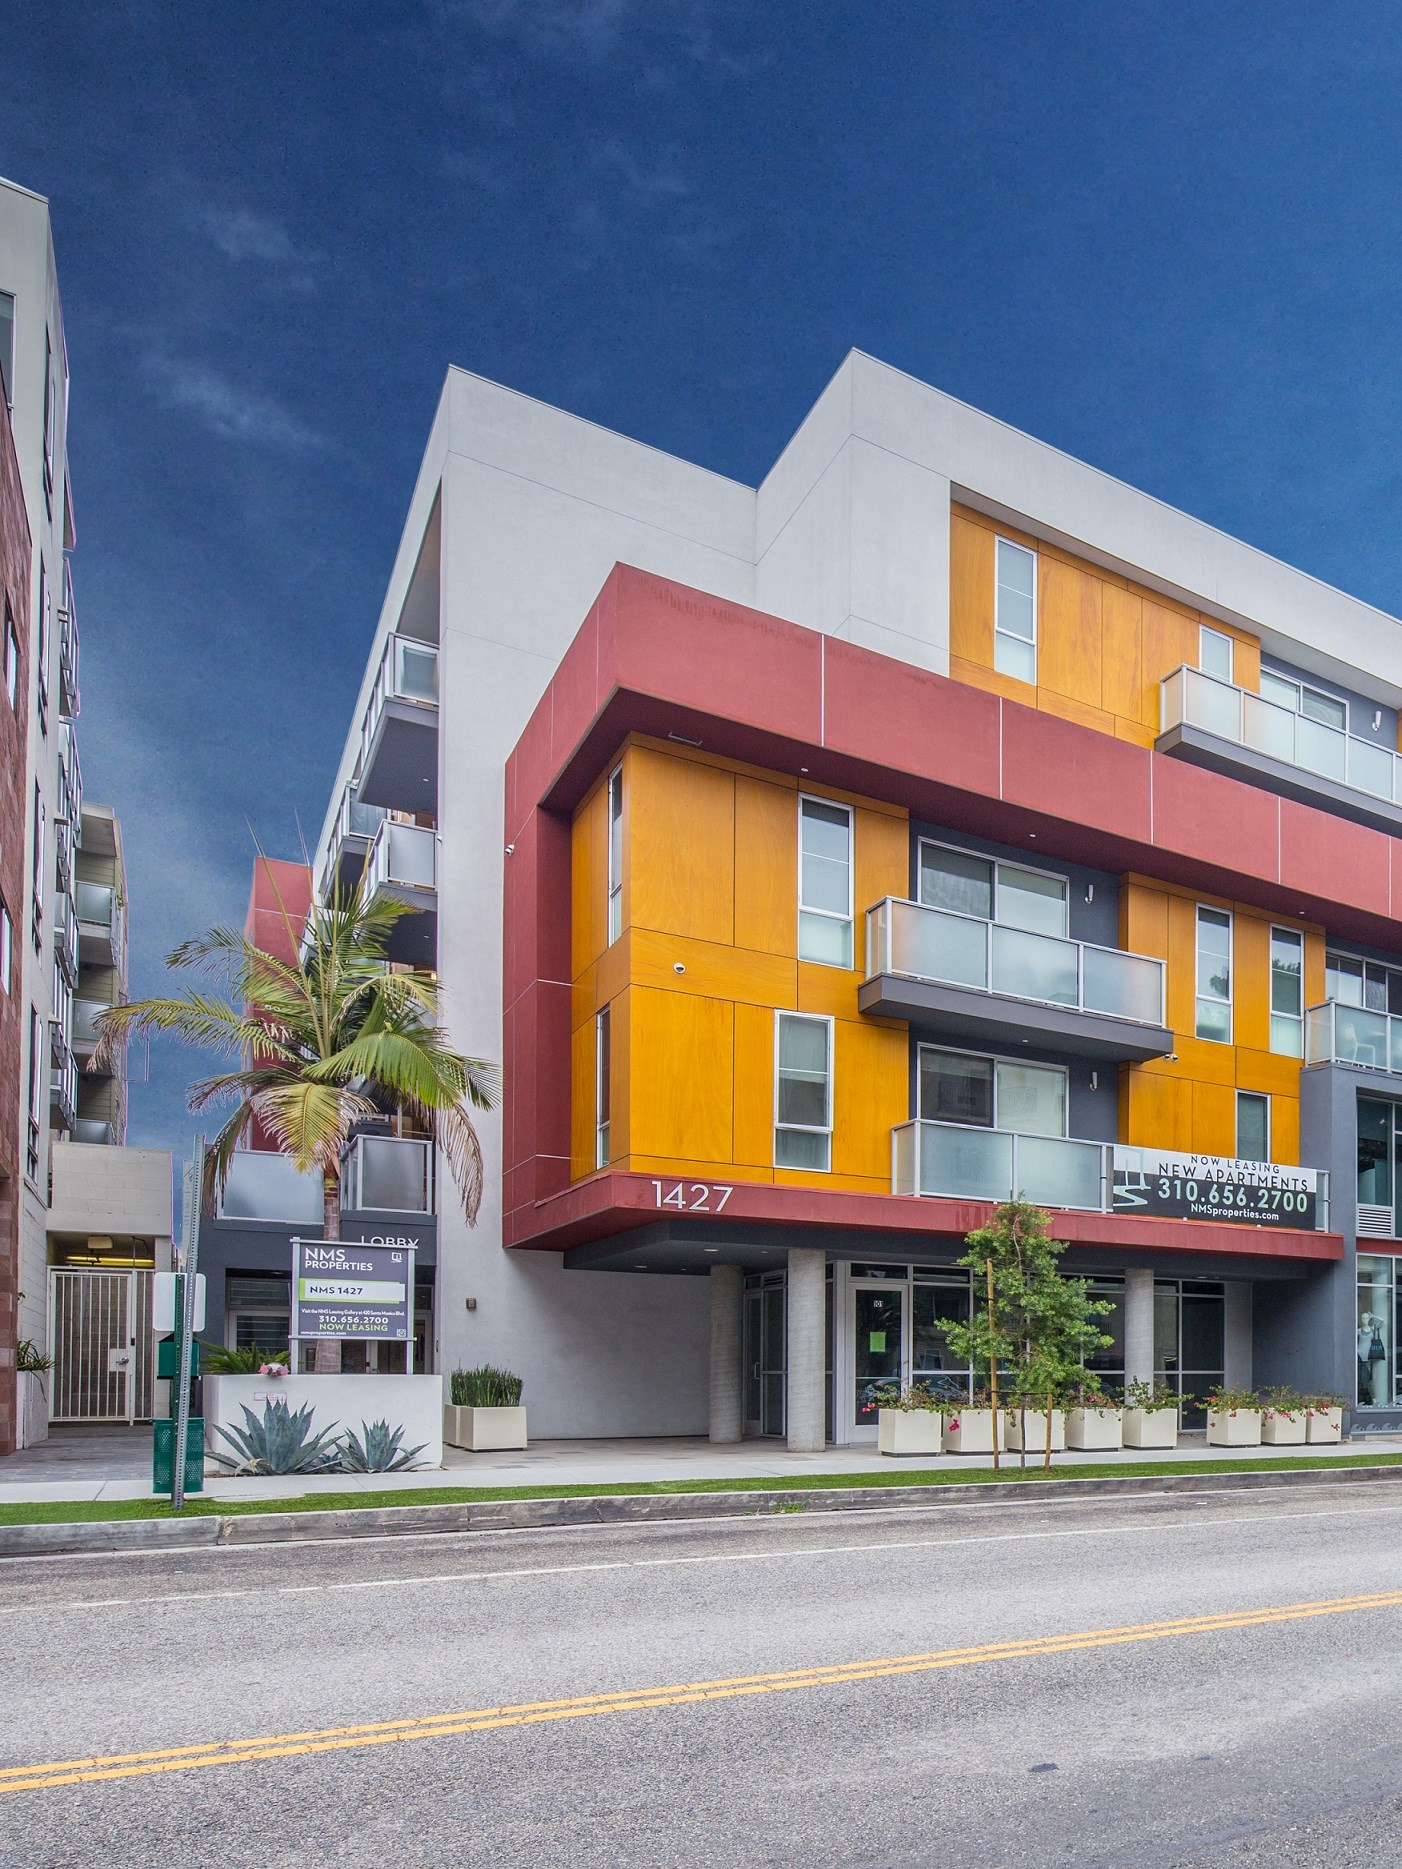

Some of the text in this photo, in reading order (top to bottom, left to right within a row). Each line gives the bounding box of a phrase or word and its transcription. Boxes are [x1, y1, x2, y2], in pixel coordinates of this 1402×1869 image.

[1191, 1155, 1280, 1174] NOW LEASING
[1158, 1162, 1308, 1192] NEW APARTMENTS
[651, 1180, 734, 1212] 1427
[1158, 1177, 1308, 1213] 310.656.2700
[1190, 1202, 1280, 1221] NMSproperties.com
[305, 1247, 346, 1262] NMS
[305, 1260, 373, 1271] PROPERTIES
[309, 1286, 363, 1295] NMS 1427
[318, 1315, 389, 1324] 310.656.2700
[319, 1323, 389, 1332] NOW LEASING
